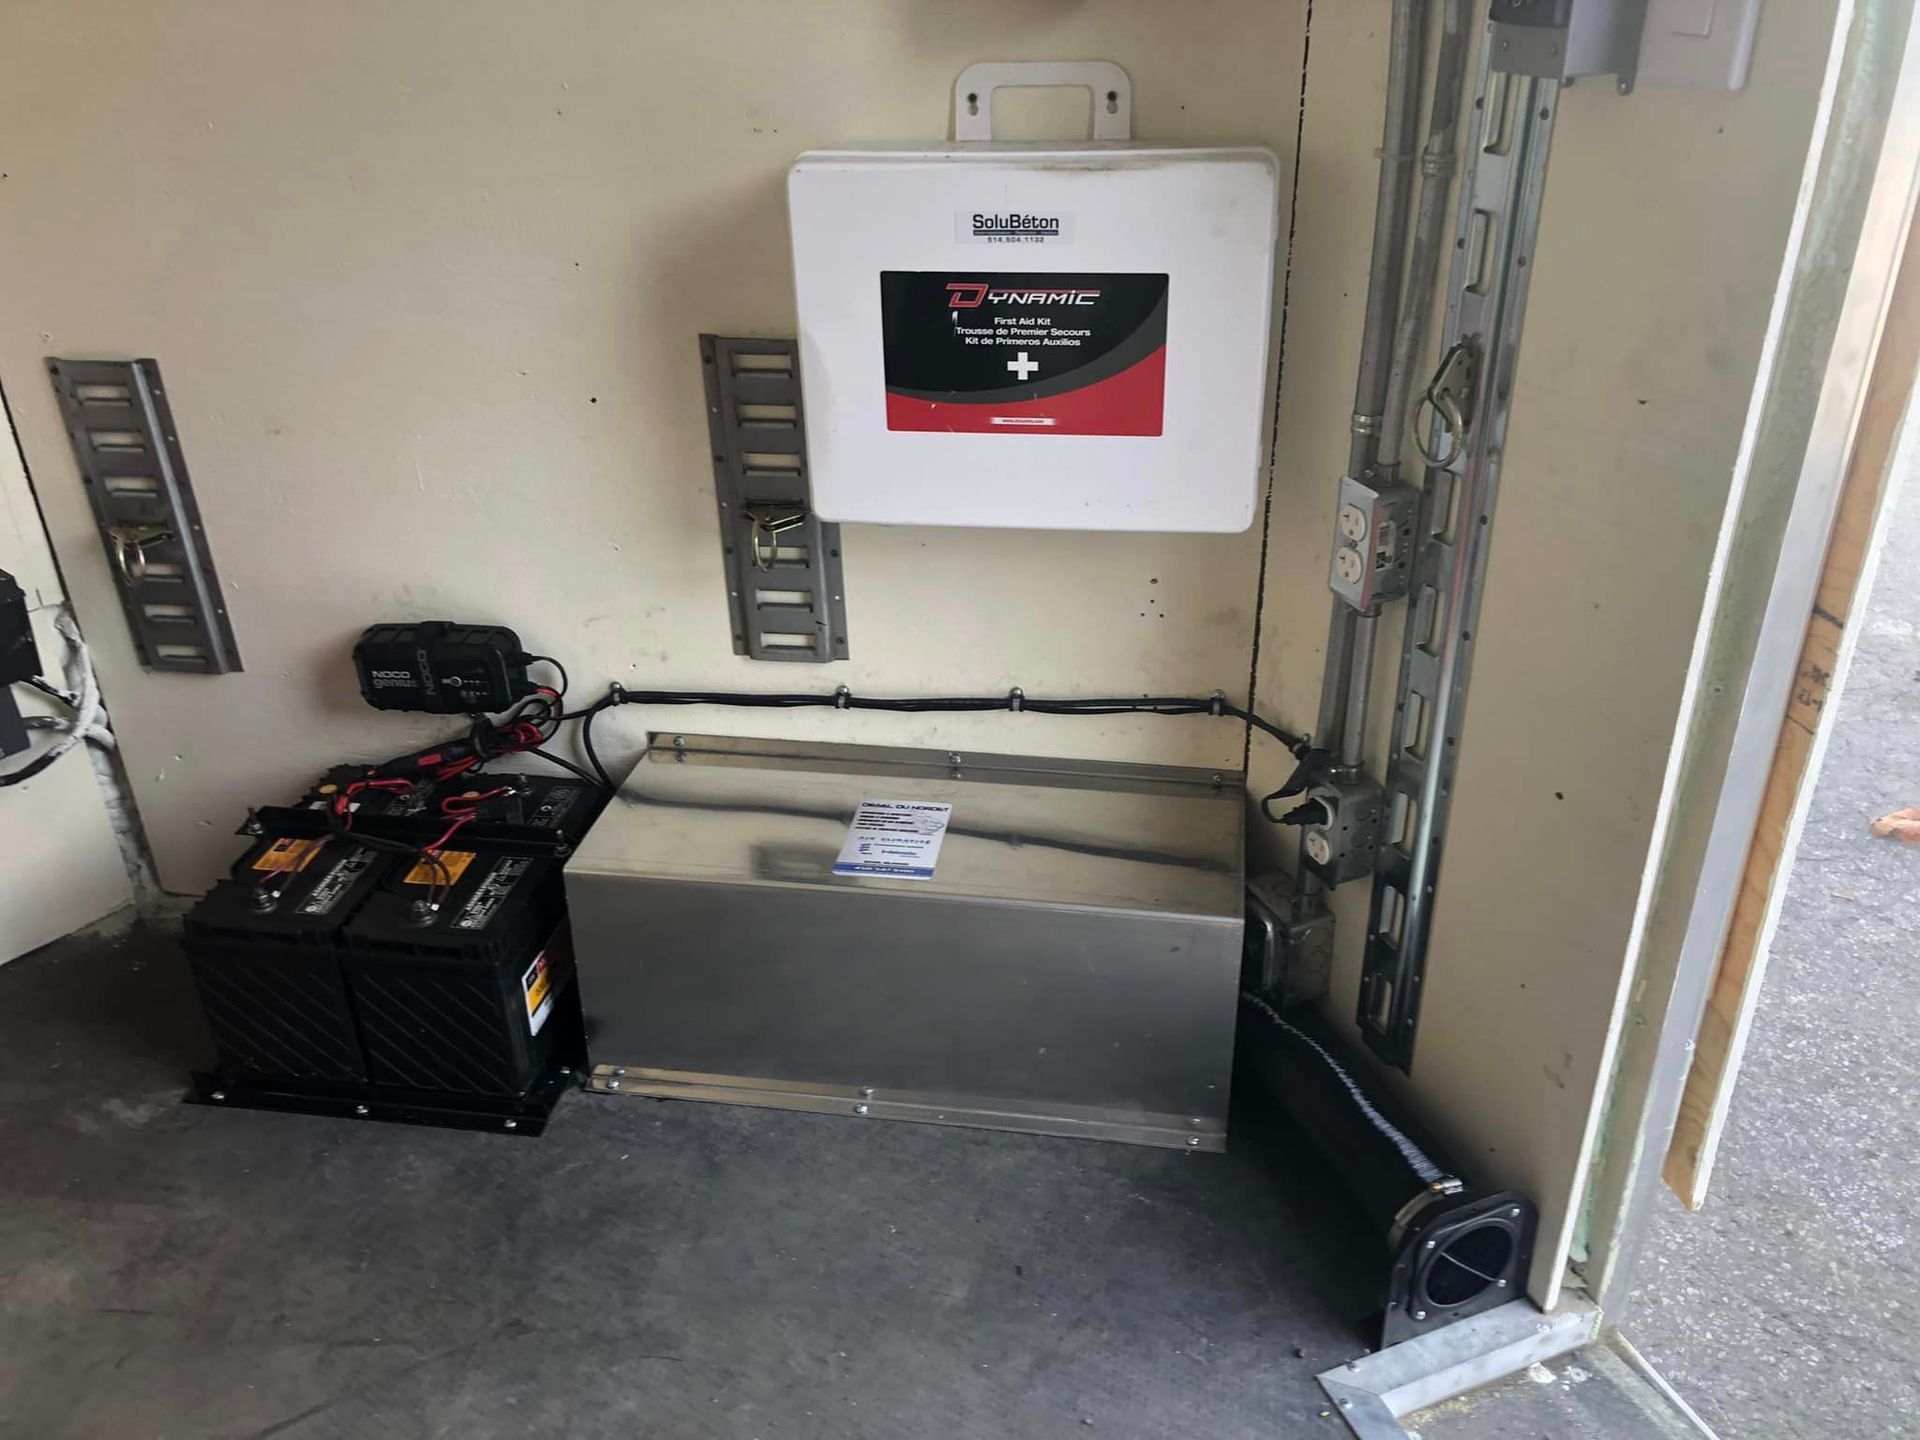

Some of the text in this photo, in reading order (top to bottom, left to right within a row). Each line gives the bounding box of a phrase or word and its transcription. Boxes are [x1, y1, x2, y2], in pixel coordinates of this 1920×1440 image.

[972, 213, 1060, 229] SoluBéton
[994, 317, 1052, 326] First Aid Kit
[956, 326, 1092, 337] Trousse de Premier Secours
[965, 336, 1081, 347] Kit de Primeros Auxilios
[371, 670, 411, 679] NOCO
